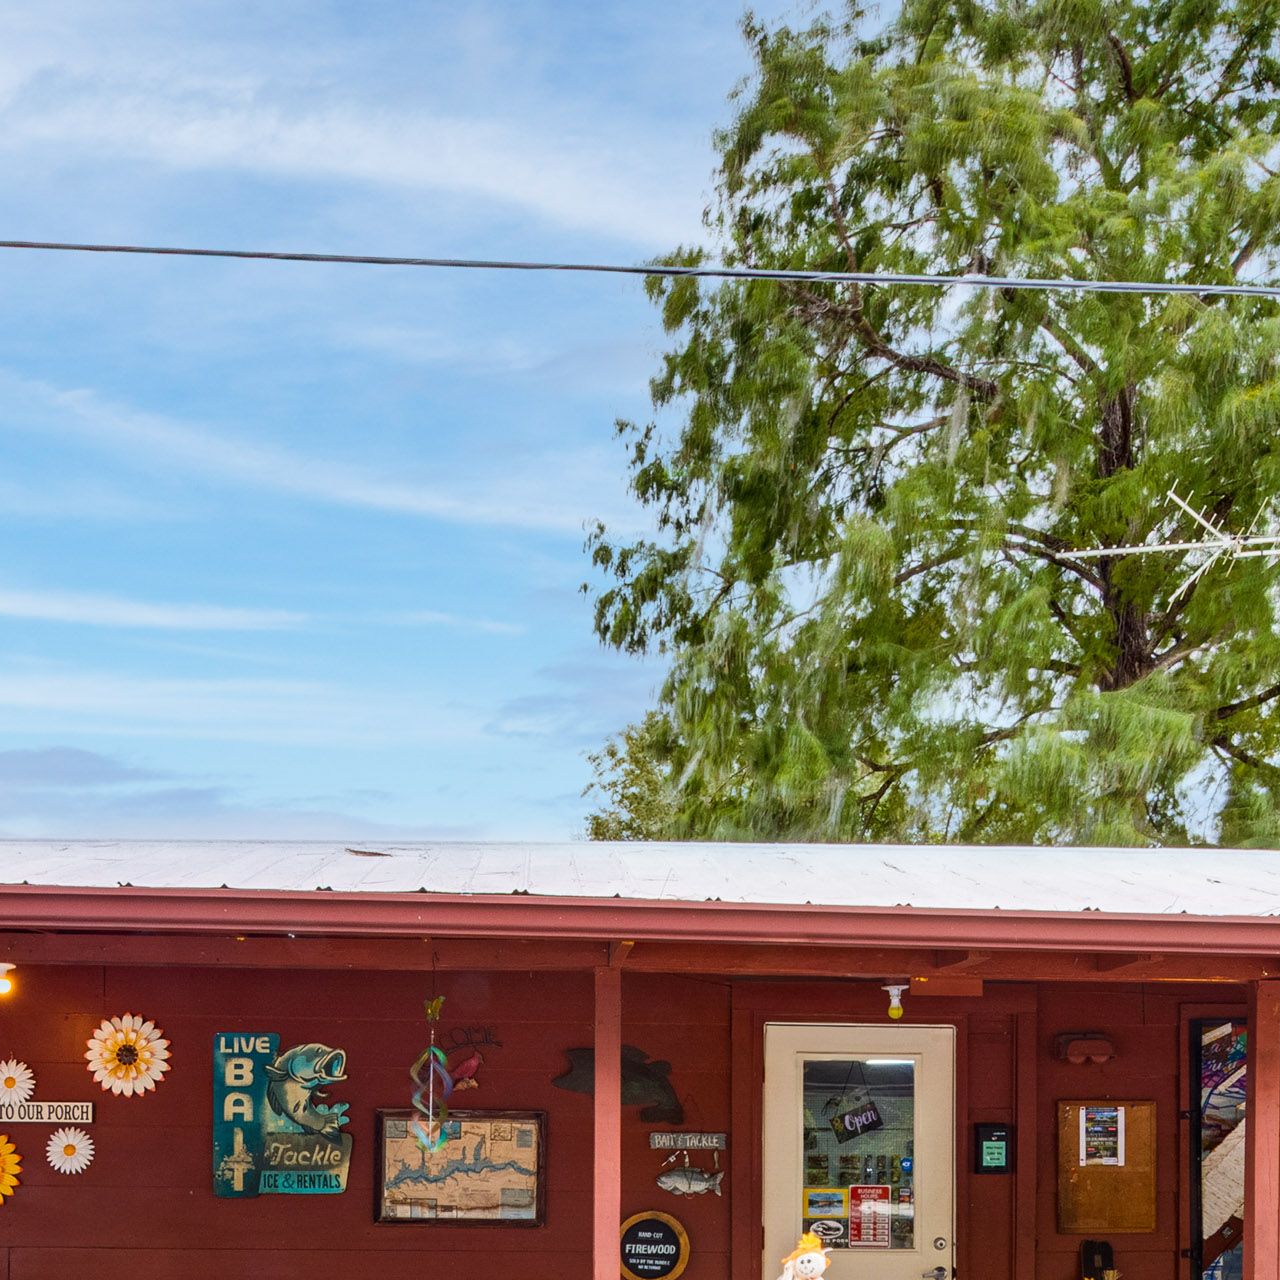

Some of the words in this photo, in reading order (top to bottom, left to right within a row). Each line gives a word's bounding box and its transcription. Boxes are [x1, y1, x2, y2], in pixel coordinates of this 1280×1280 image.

[220, 1036, 270, 1054] LIVE
[18, 1104, 44, 1120] OUR
[48, 1104, 90, 1121] PORCH
[844, 1110, 877, 1134] Open
[655, 1135, 675, 1146] BAIT
[685, 1135, 720, 1146] TACKLE
[270, 1143, 342, 1166] Tackle
[264, 1174, 278, 1188] ICE
[282, 1174, 294, 1189] &
[297, 1174, 341, 1189] RENTALS
[625, 1244, 676, 1254] FIREWOOD
